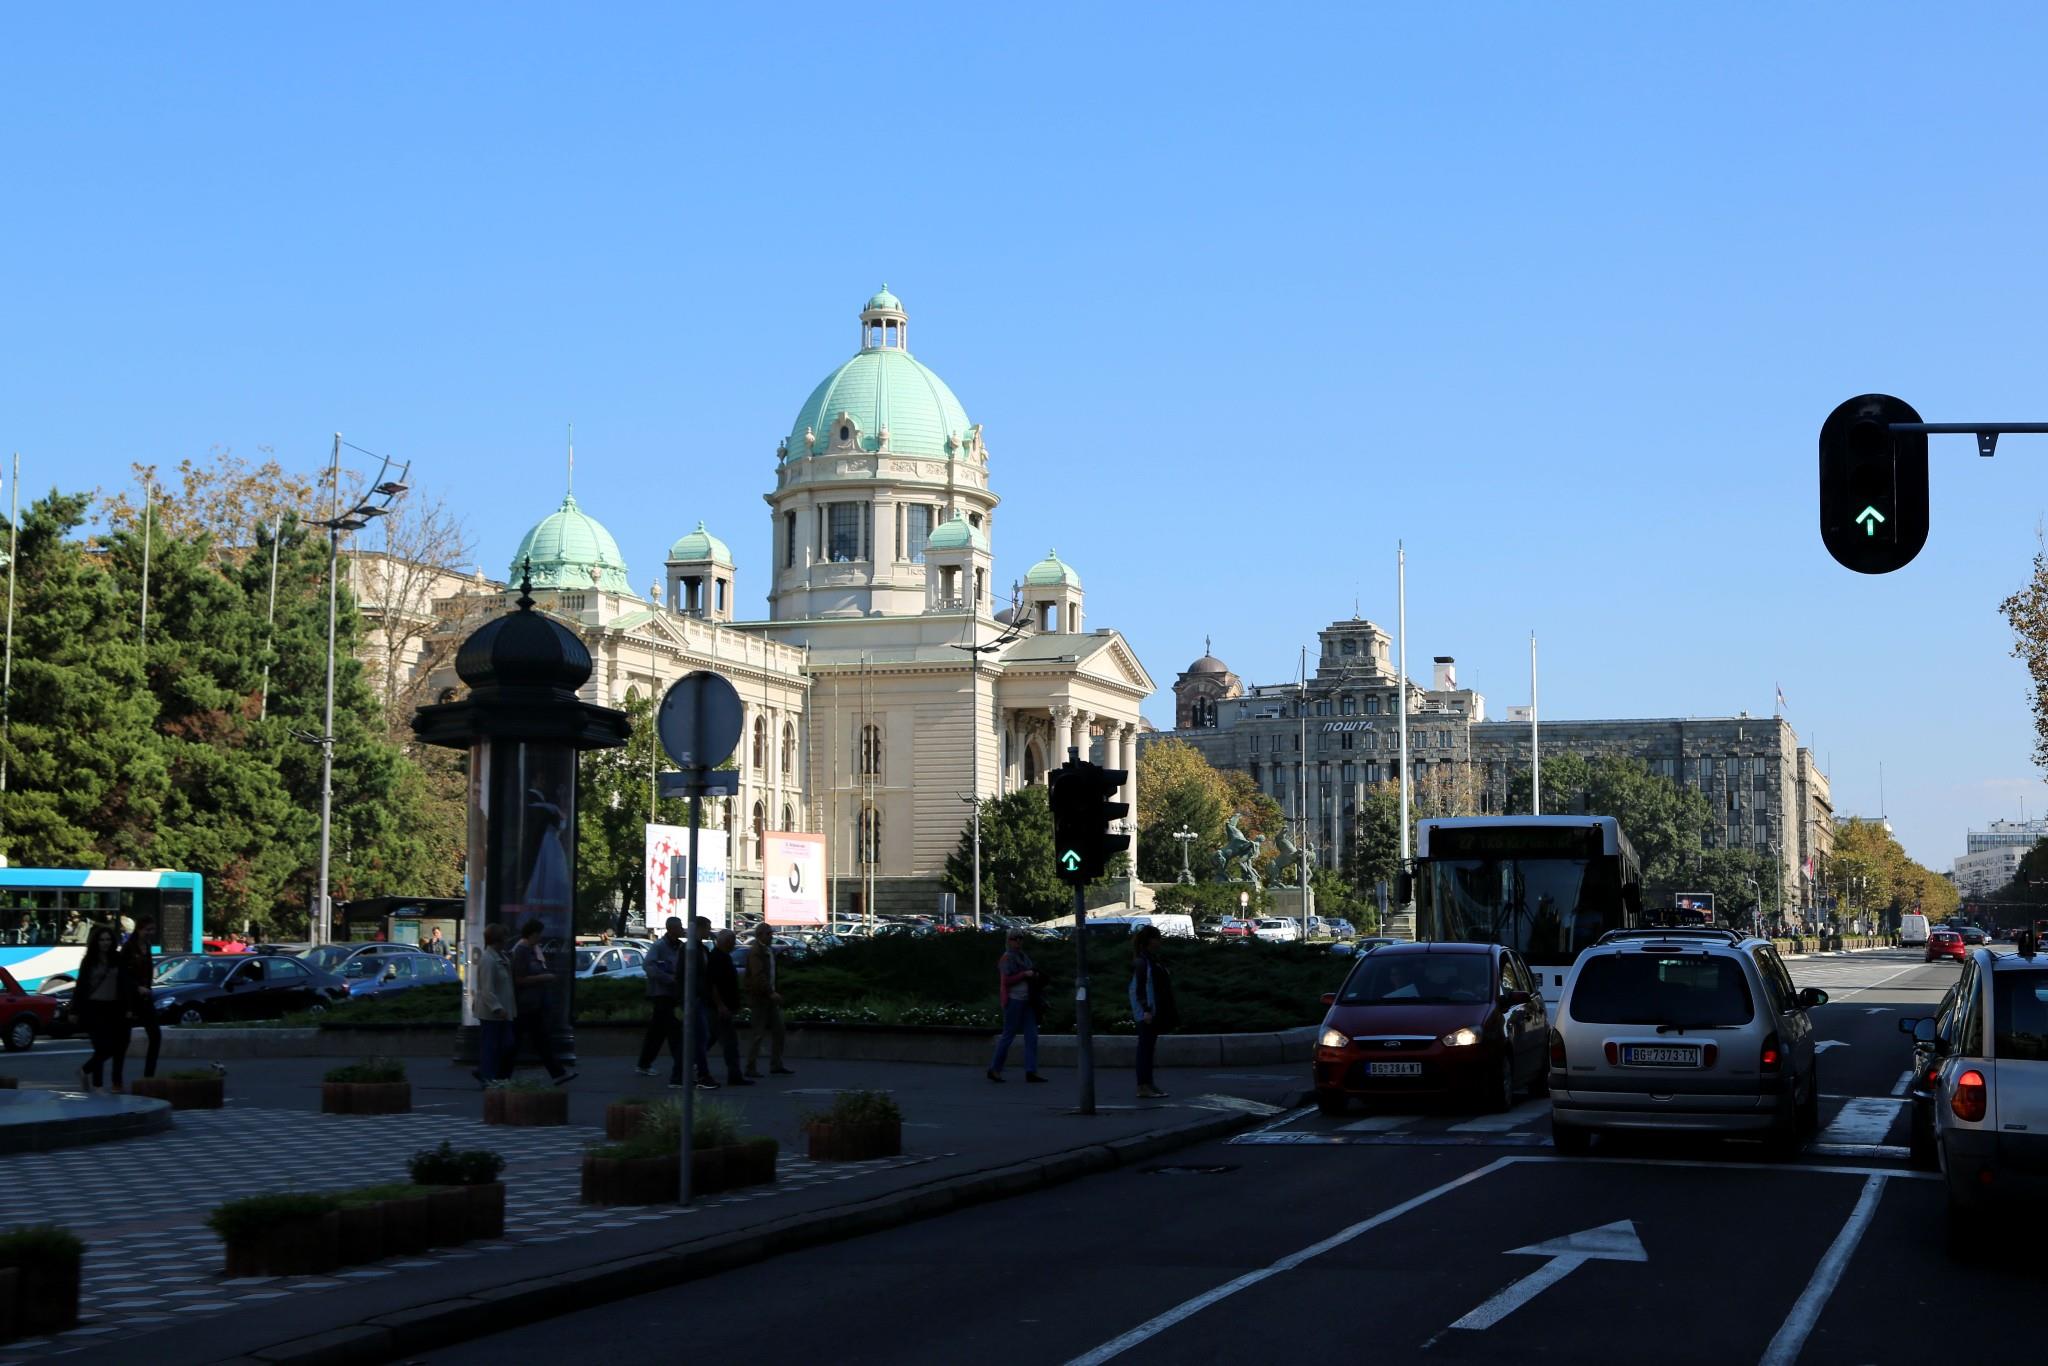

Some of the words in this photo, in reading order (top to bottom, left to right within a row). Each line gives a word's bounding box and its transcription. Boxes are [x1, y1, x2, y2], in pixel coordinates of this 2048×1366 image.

[1322, 721, 1374, 732] ПОШТА
[1634, 1048, 1646, 1061] BG
[1372, 1064, 1383, 1073] BG
